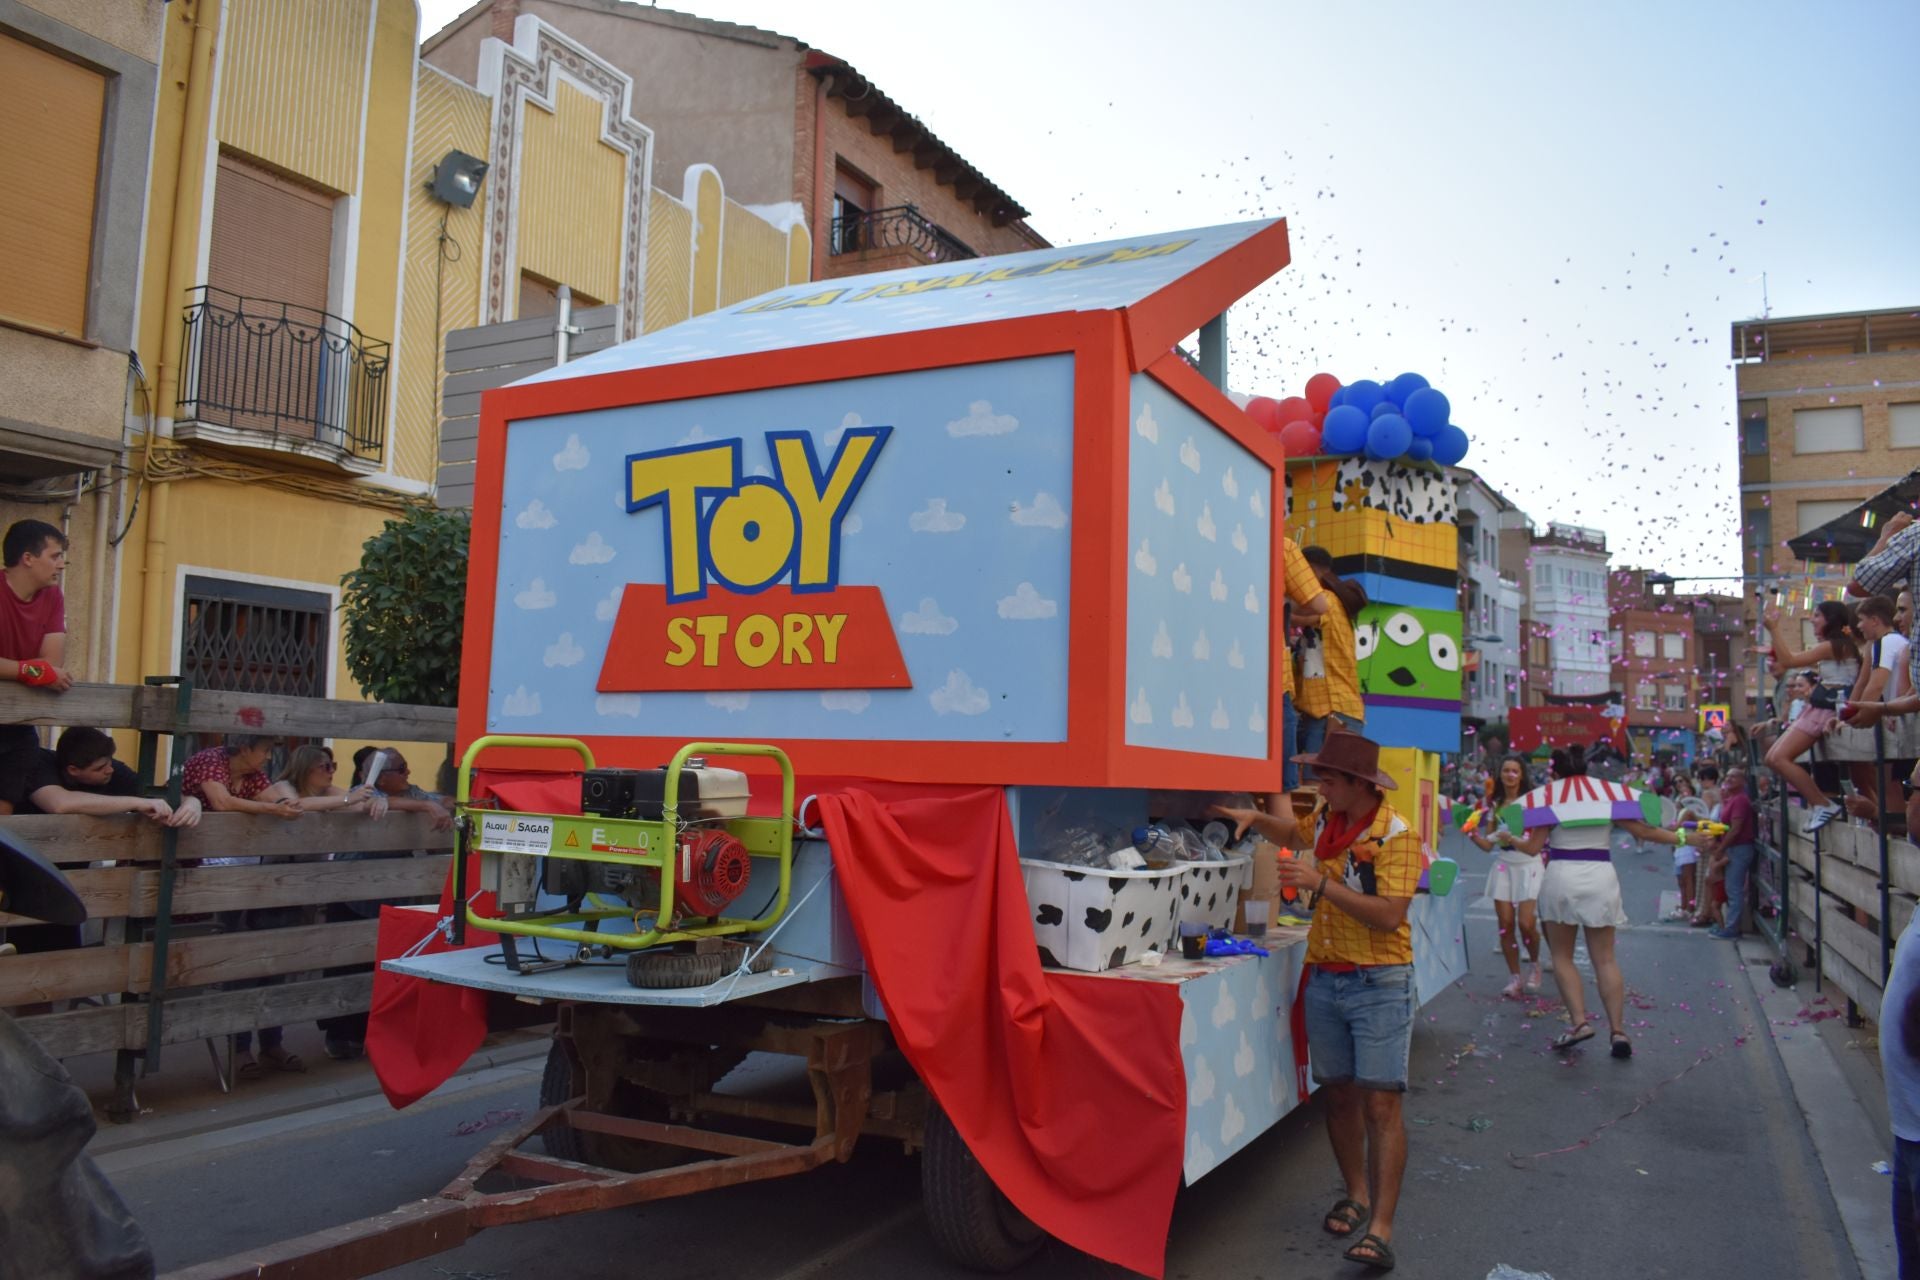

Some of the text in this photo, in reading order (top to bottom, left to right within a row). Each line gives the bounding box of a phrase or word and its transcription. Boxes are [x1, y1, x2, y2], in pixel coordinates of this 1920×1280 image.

[625, 425, 894, 605] TOY
[664, 612, 848, 668] STORY
[518, 822, 550, 834] SAGAR
